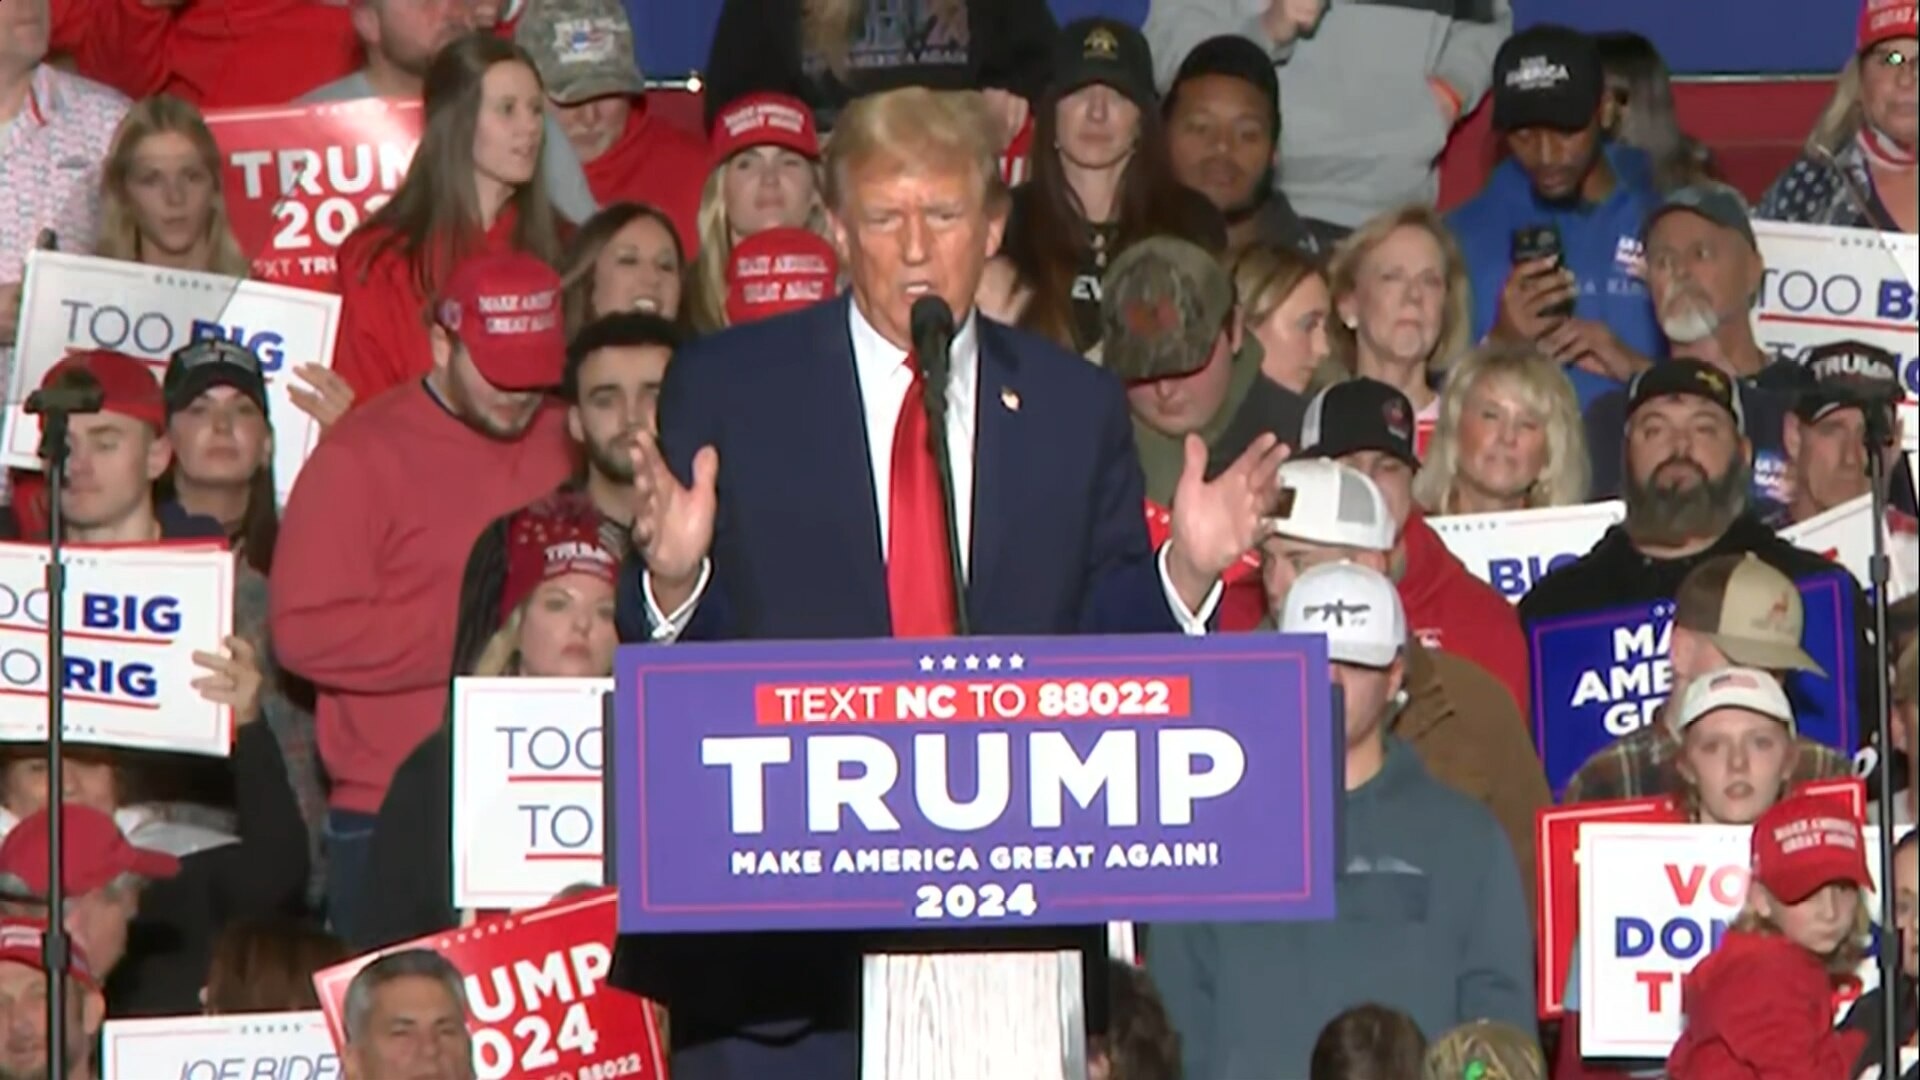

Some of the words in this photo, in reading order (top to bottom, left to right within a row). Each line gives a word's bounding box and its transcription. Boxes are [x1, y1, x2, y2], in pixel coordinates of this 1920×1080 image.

[1877, 280, 1919, 320] B
[61, 299, 173, 354] TOO
[82, 593, 181, 633] BIG
[62, 656, 157, 698] RIG
[1571, 660, 1673, 707] AME
[776, 687, 882, 721] TEXT
[896, 685, 957, 717] NC
[969, 685, 1025, 717] TO
[1037, 681, 1169, 715] 88022
[495, 725, 603, 771] TOO
[702, 728, 1246, 834] TRUMP
[518, 805, 594, 848] TO
[731, 849, 822, 875] MAKE
[833, 846, 979, 873] AMERICA
[989, 844, 1094, 871] GREAT
[1105, 842, 1220, 868] AGAIN!
[915, 883, 1037, 918] 2024
[1636, 970, 1690, 1014] T
[249, 1053, 342, 1080] BIDE
